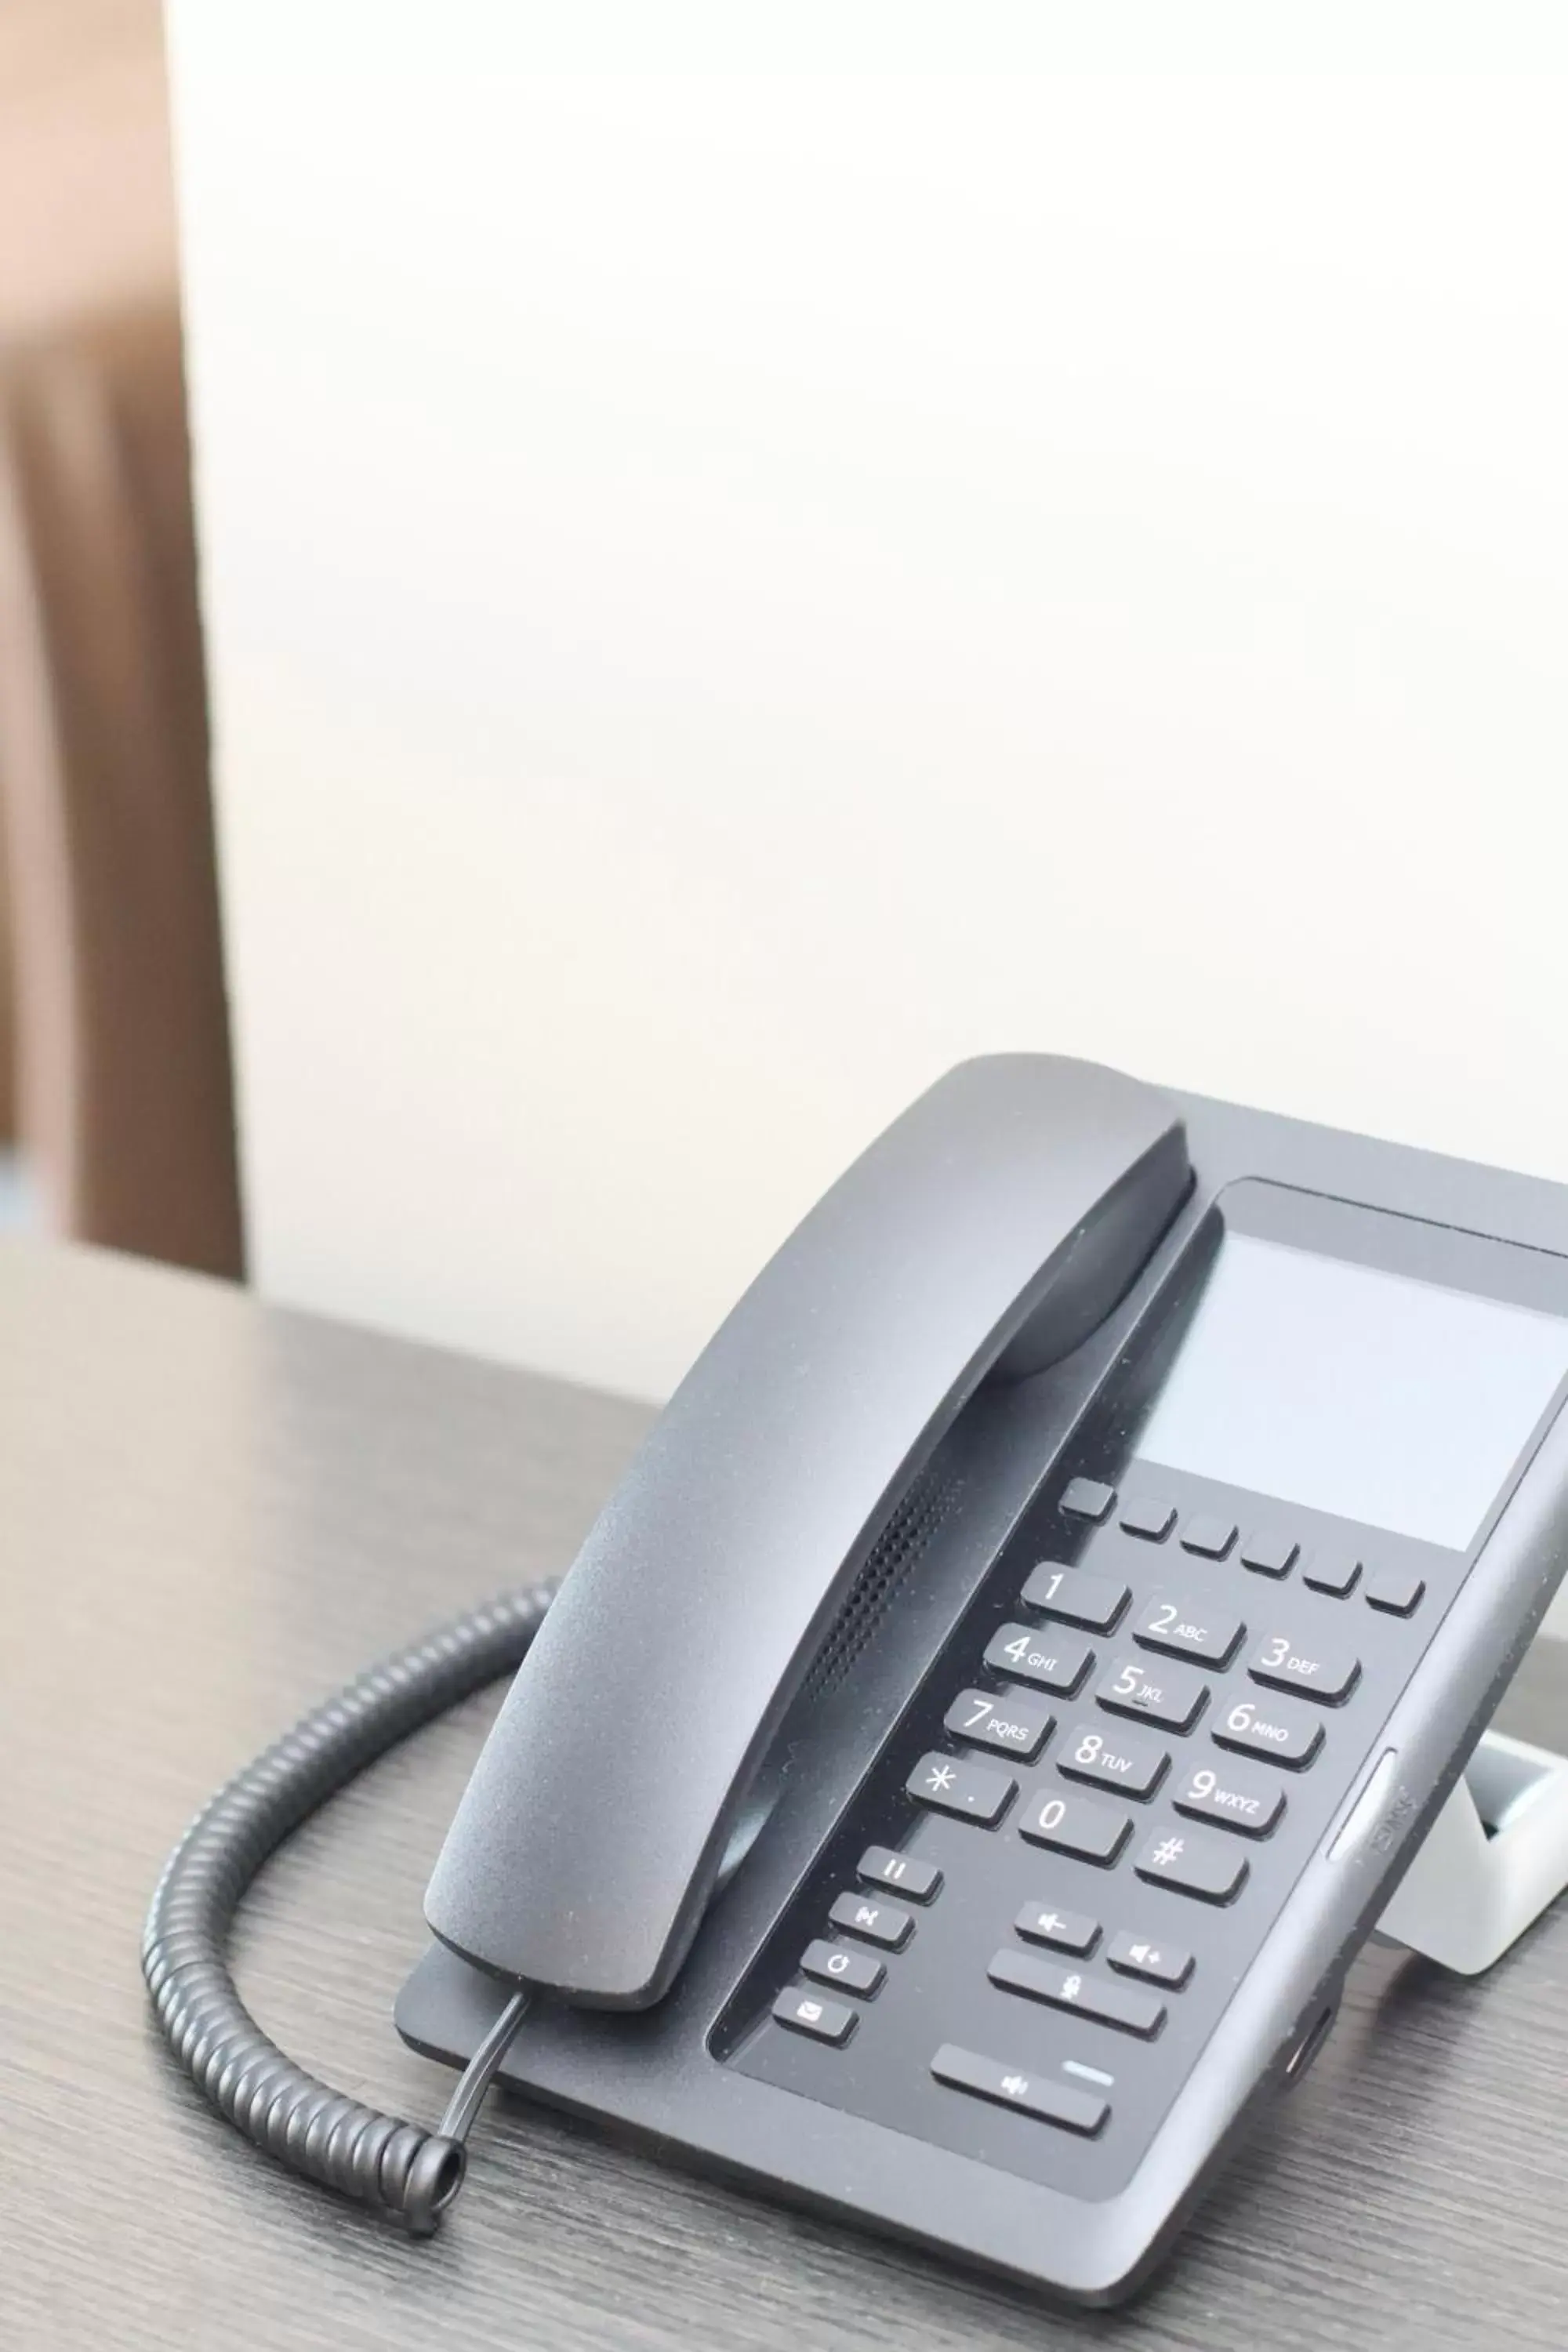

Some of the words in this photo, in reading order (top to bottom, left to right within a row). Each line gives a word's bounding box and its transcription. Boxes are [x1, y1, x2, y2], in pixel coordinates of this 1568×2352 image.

[1046, 1574, 1063, 1599] 1
[1149, 1605, 1177, 1634] 2
[1174, 1624, 1207, 1642] ABC
[1004, 1637, 1027, 1662] 4
[1028, 1653, 1057, 1671] GHI
[1261, 1639, 1290, 1668] 3
[1288, 1657, 1319, 1675] DEF
[1113, 1666, 1144, 1694] 5
[1136, 1682, 1162, 1702] JKL
[964, 1700, 993, 1729] 7
[988, 1719, 1029, 1740] PQRS
[1228, 1704, 1256, 1732] 6
[1253, 1722, 1288, 1741] MNO
[1076, 1736, 1101, 1762] 8
[1102, 1754, 1132, 1772] TUV
[1189, 1771, 1217, 1801] 9
[1214, 1788, 1259, 1813] WXYZ
[1040, 1801, 1065, 1828] 0
[1153, 1838, 1183, 1864] #
